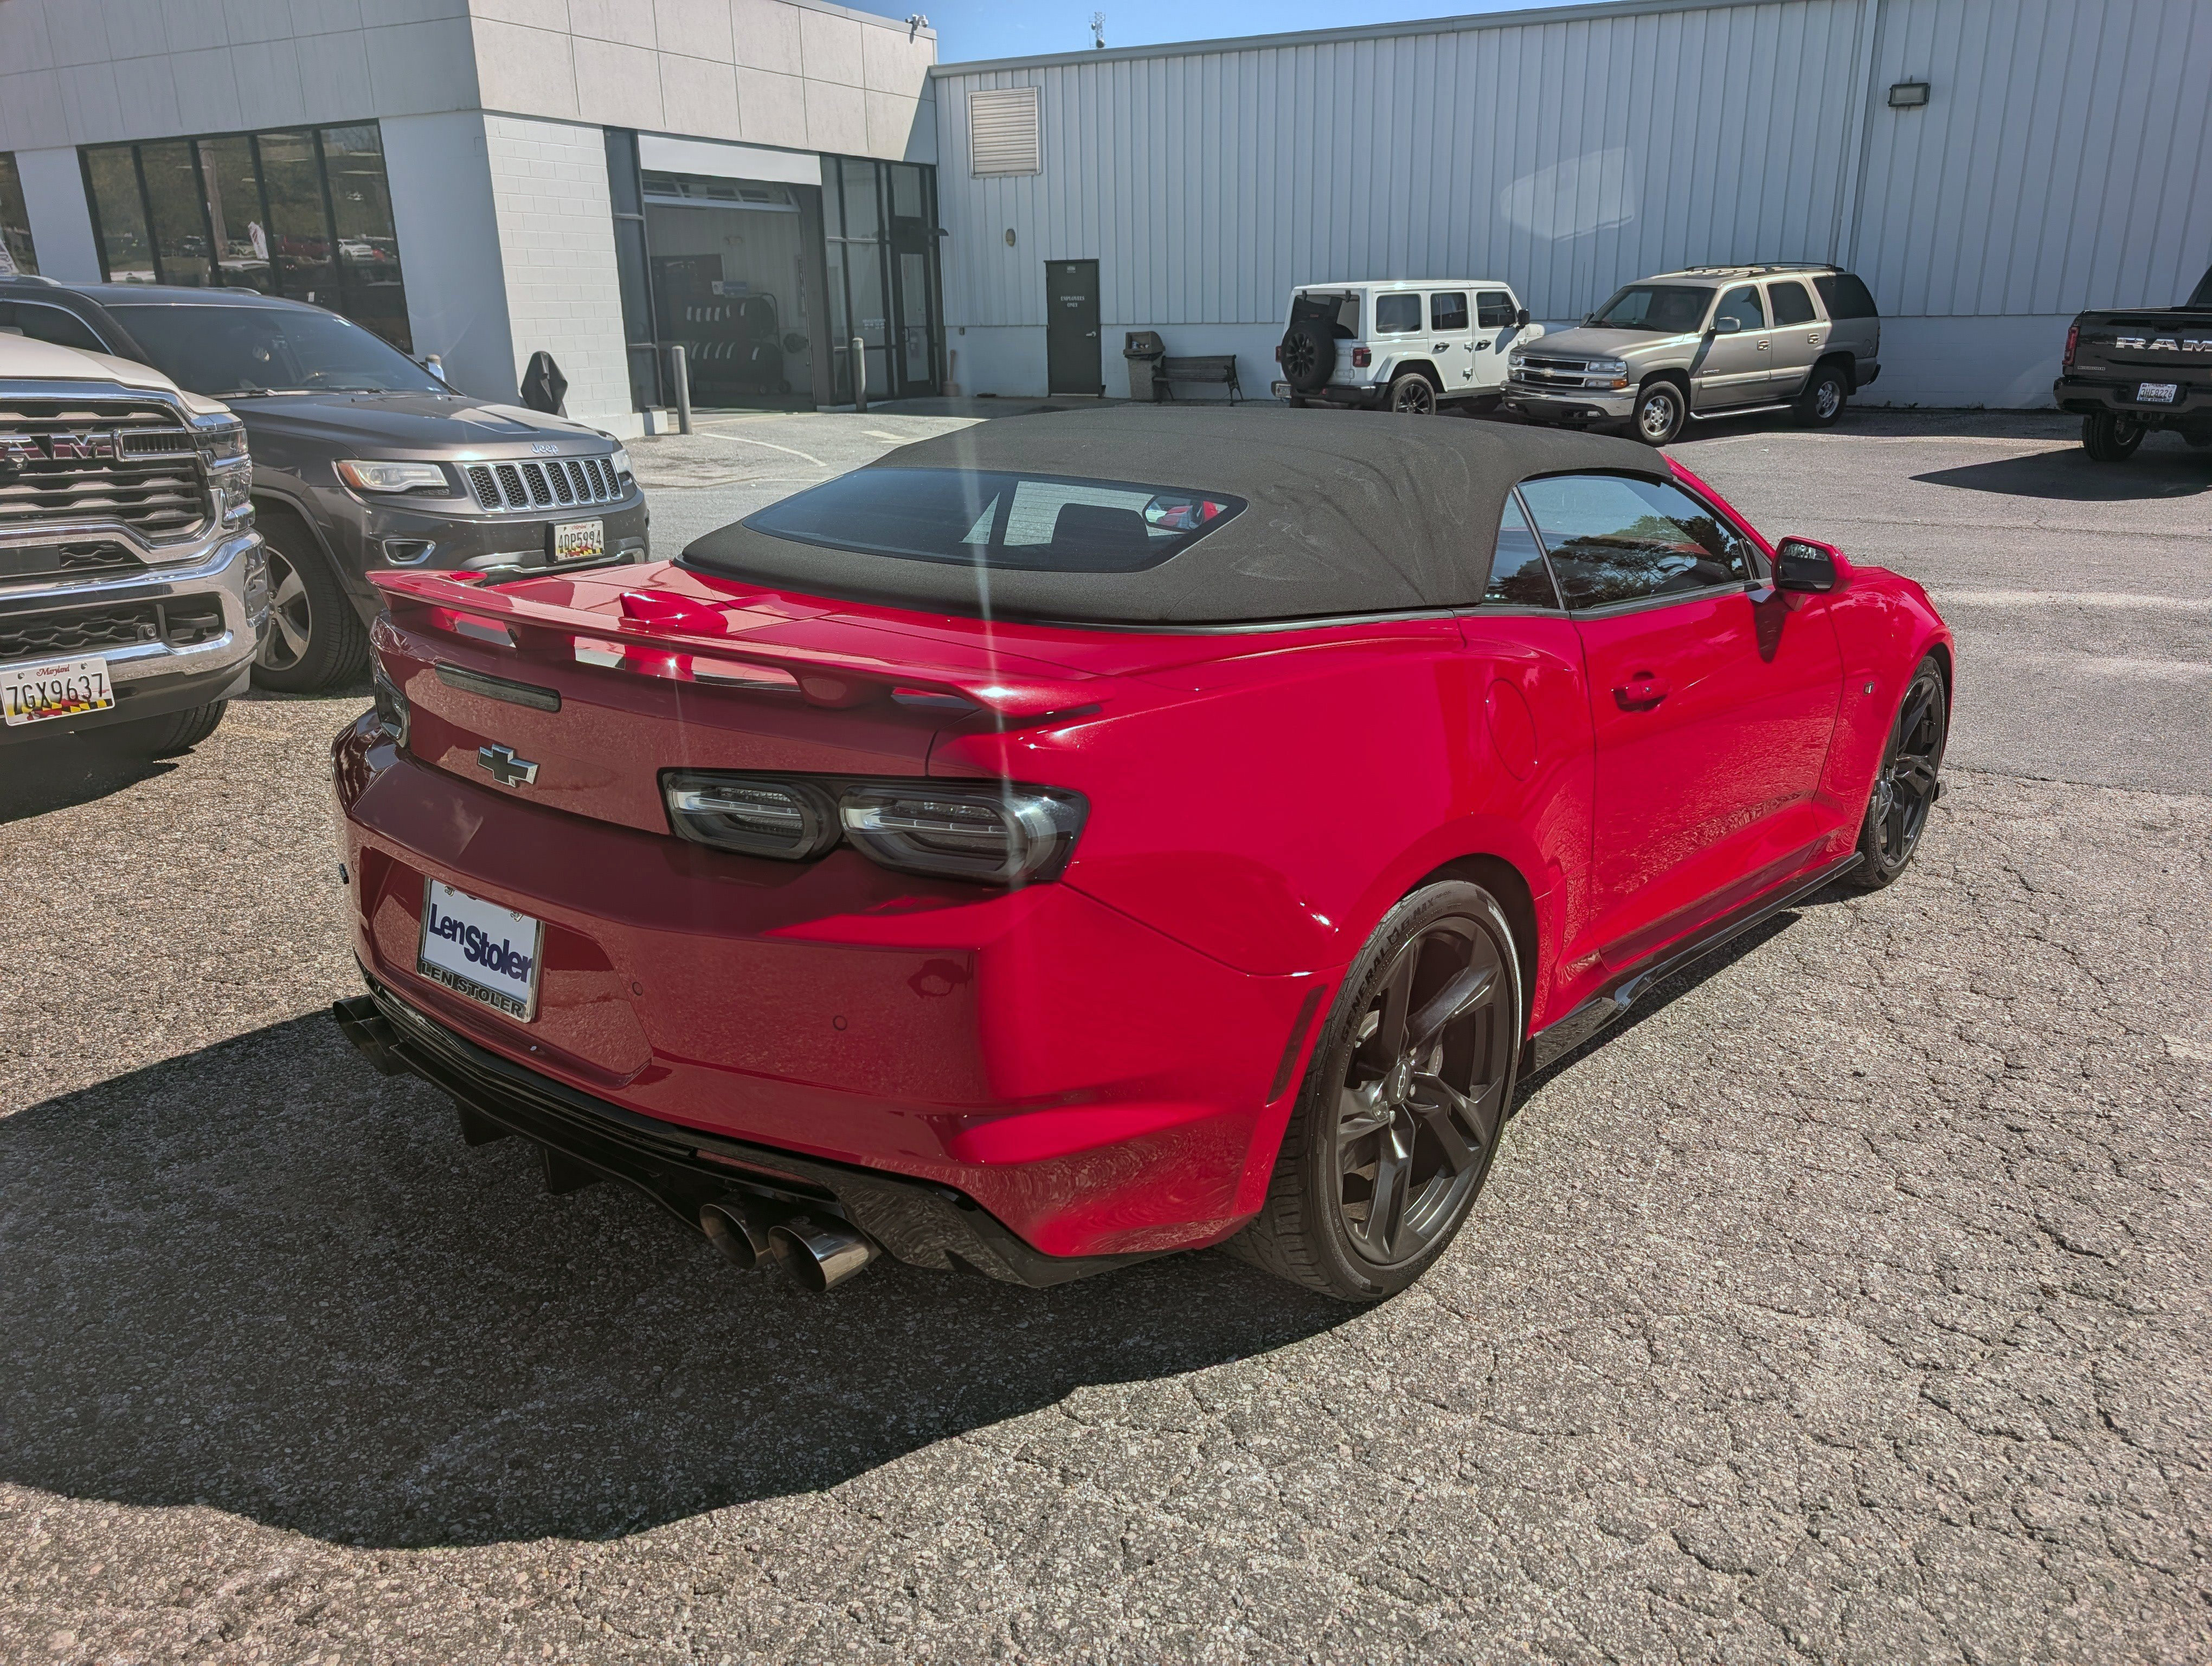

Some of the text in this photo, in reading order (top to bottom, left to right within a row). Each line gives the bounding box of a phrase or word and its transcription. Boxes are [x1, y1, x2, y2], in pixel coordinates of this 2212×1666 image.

[2115, 337, 2212, 352] RAM
[0, 434, 113, 461] AM
[531, 443, 558, 455] Jeep
[36, 664, 70, 676] Maryland
[5, 672, 103, 715] 7GX9637
[421, 962, 524, 1019] LEN STOLER
[1340, 946, 1388, 1043] GENERAL
